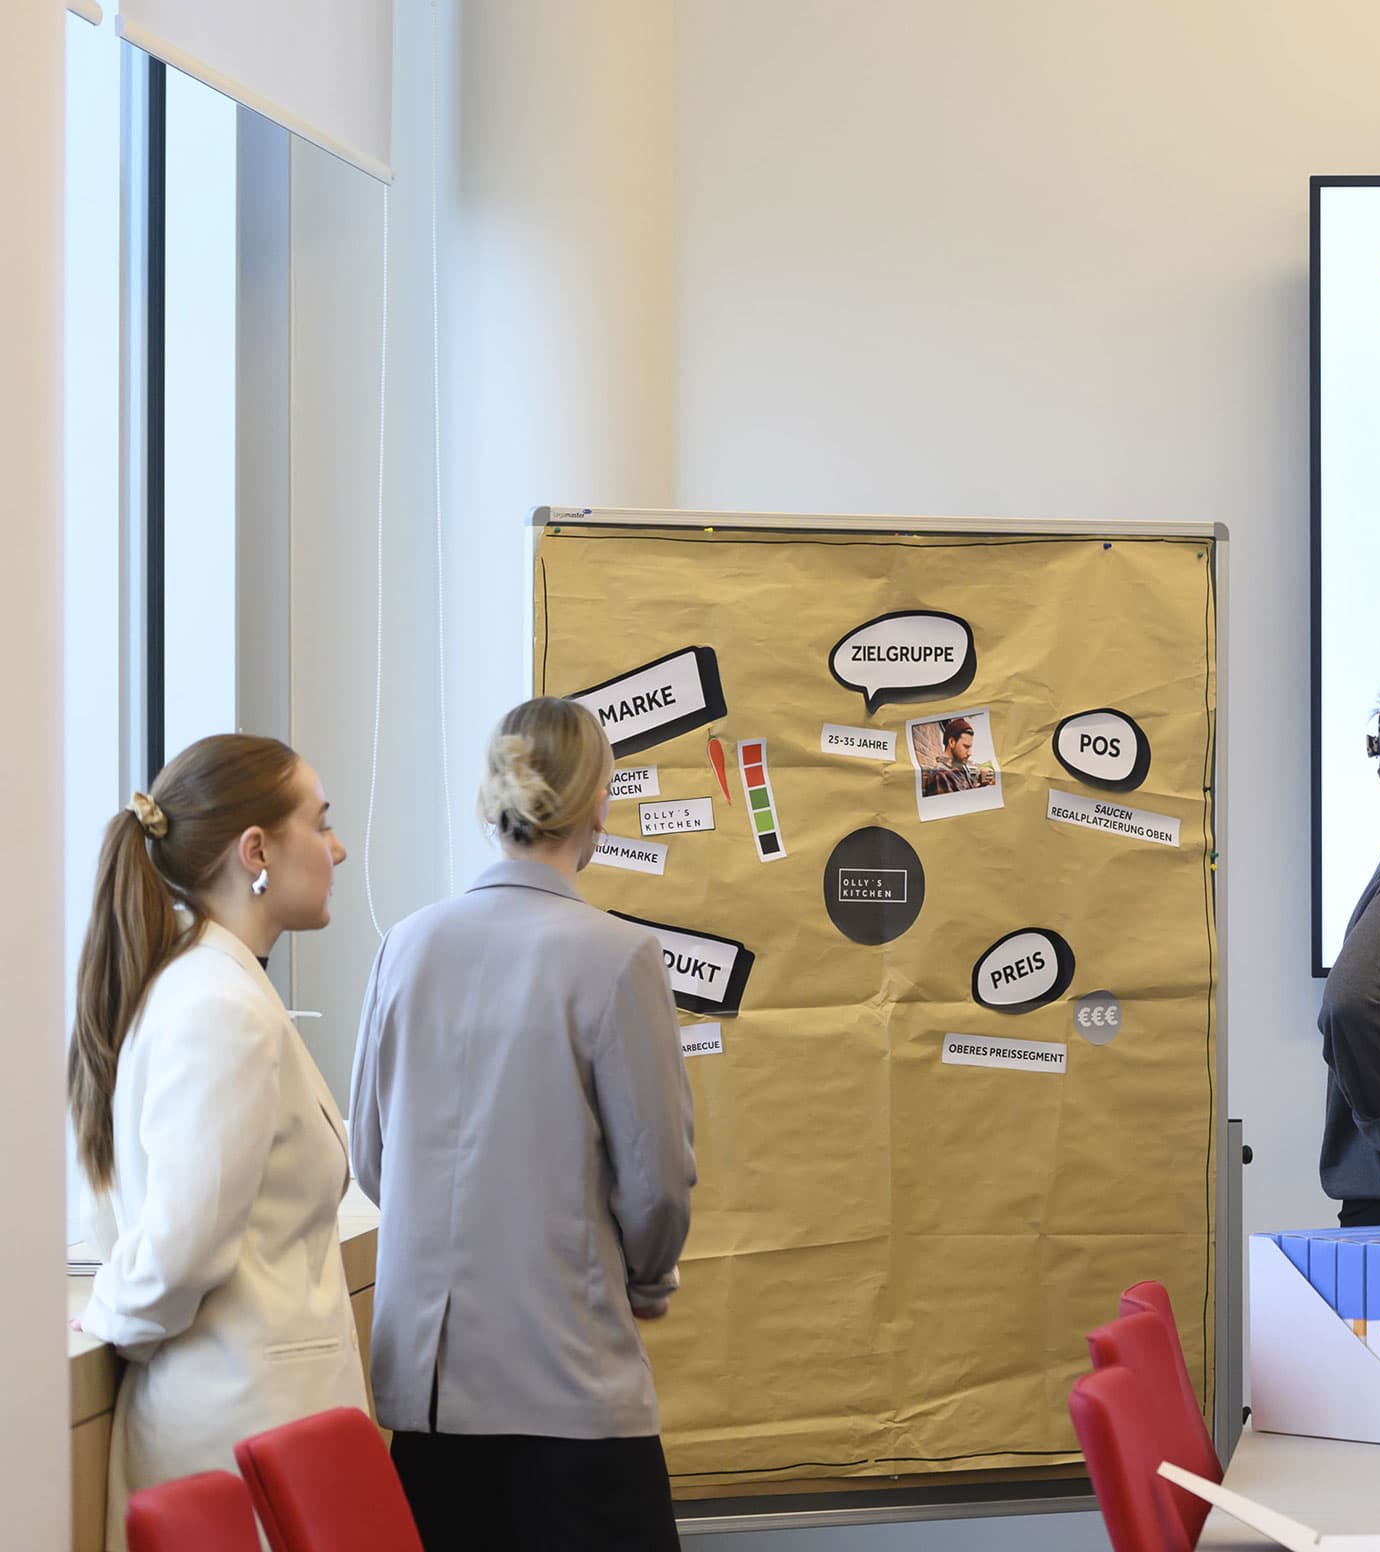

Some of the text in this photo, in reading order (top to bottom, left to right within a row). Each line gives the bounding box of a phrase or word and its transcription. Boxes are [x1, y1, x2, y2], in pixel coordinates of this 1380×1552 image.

[852, 646, 954, 662] ZIELGRUPPE
[598, 685, 676, 727] MARKE
[828, 735, 889, 750] 25-35 JAHRE
[1080, 733, 1121, 758] POS
[611, 770, 649, 783] ACHTE
[1094, 804, 1133, 820] SAUCEN
[645, 820, 701, 831] KITCHEN
[1051, 806, 1172, 841] REGALPLATZIERUNG OBEN
[620, 848, 659, 863] MARKE
[843, 889, 892, 897] KITCHEN
[663, 949, 721, 983] DUKT
[990, 951, 1046, 989] PREIS
[1078, 1006, 1118, 1027] €€€
[682, 1041, 720, 1052] ARBECUE
[949, 1043, 1064, 1063] OBERES PREISSEGMENT
